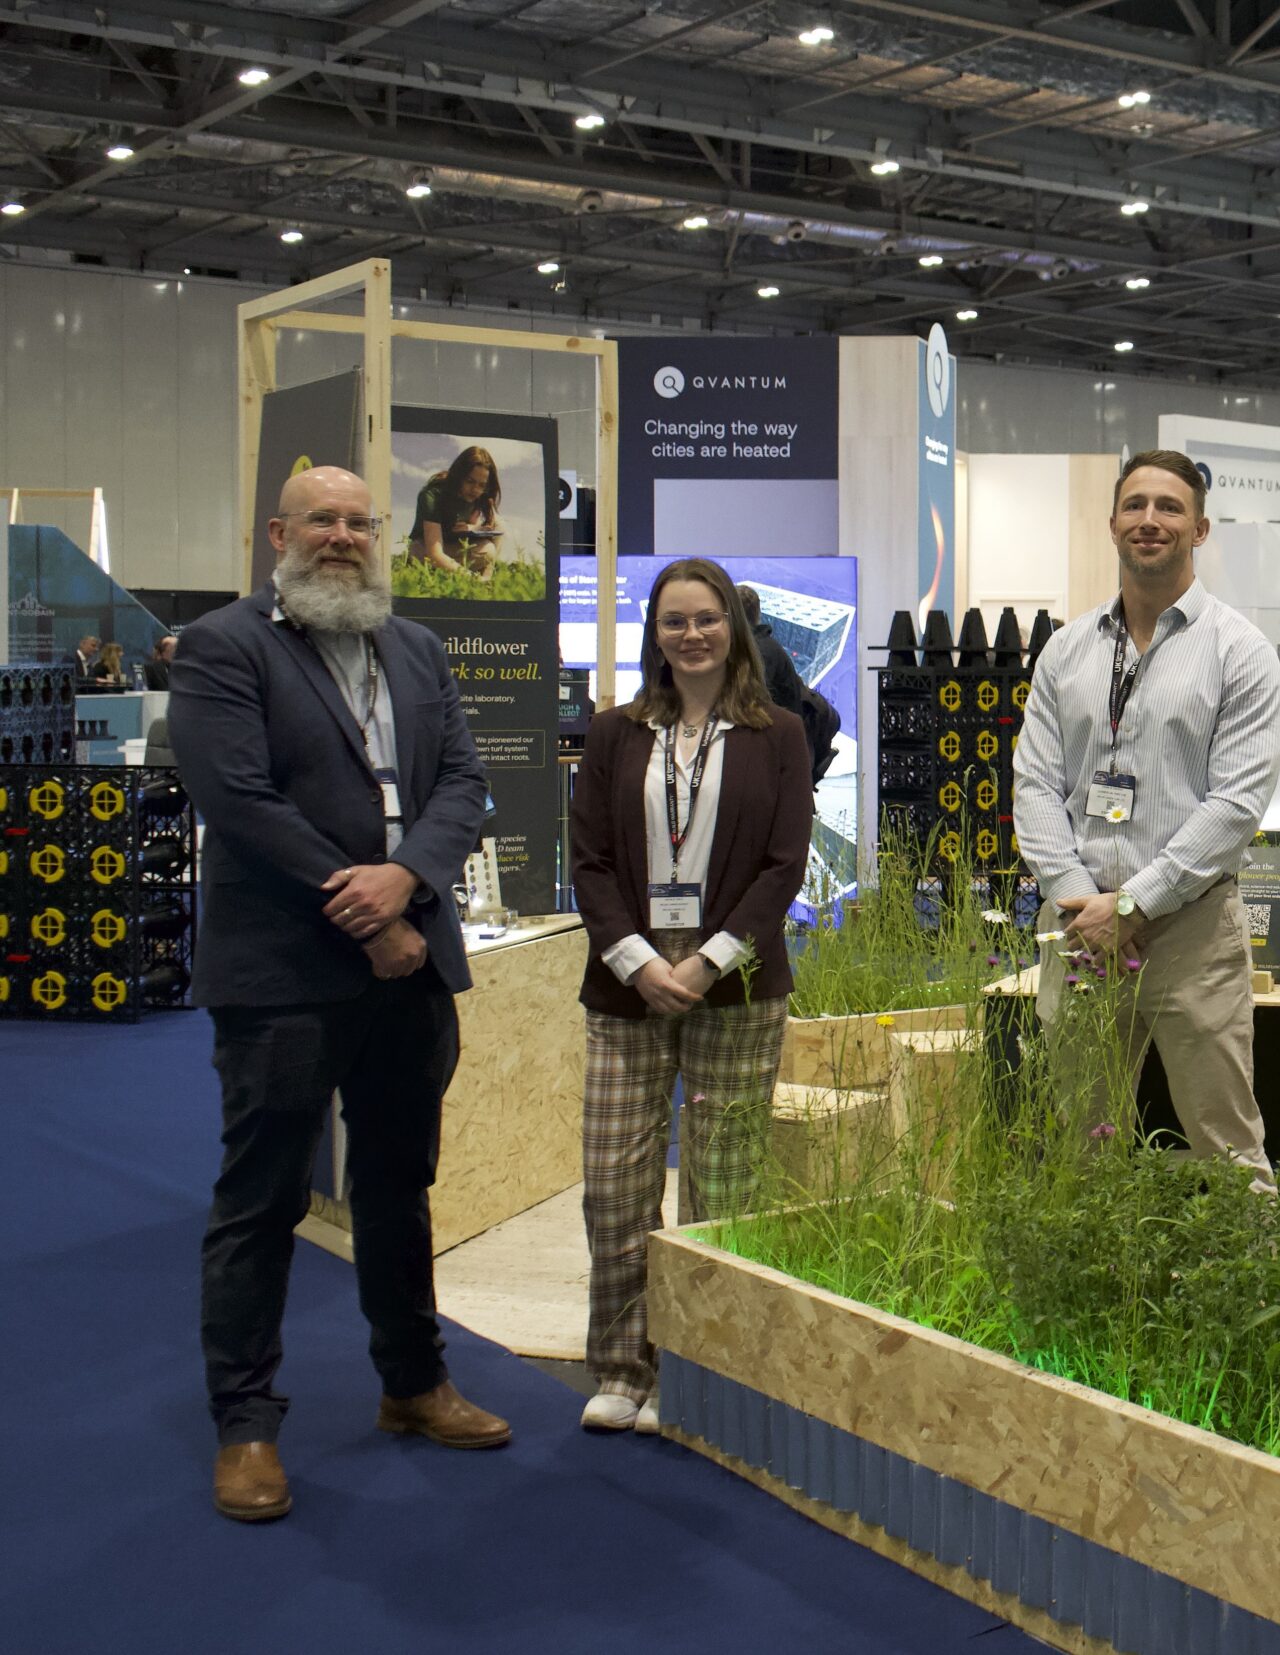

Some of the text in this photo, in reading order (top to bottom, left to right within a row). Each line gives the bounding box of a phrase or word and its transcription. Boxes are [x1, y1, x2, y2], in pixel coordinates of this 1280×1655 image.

[692, 376, 787, 391] QVANTUM
[644, 419, 798, 440] Changing the way
[651, 441, 791, 458] cities are heated
[449, 662, 542, 680] rk so well.
[1114, 661, 1122, 673] UK
[1128, 664, 1138, 676] UK
[475, 694, 516, 704] laboratory.
[666, 773, 675, 784] UK
[691, 776, 701, 788] UK
[1262, 863, 1275, 871] the
